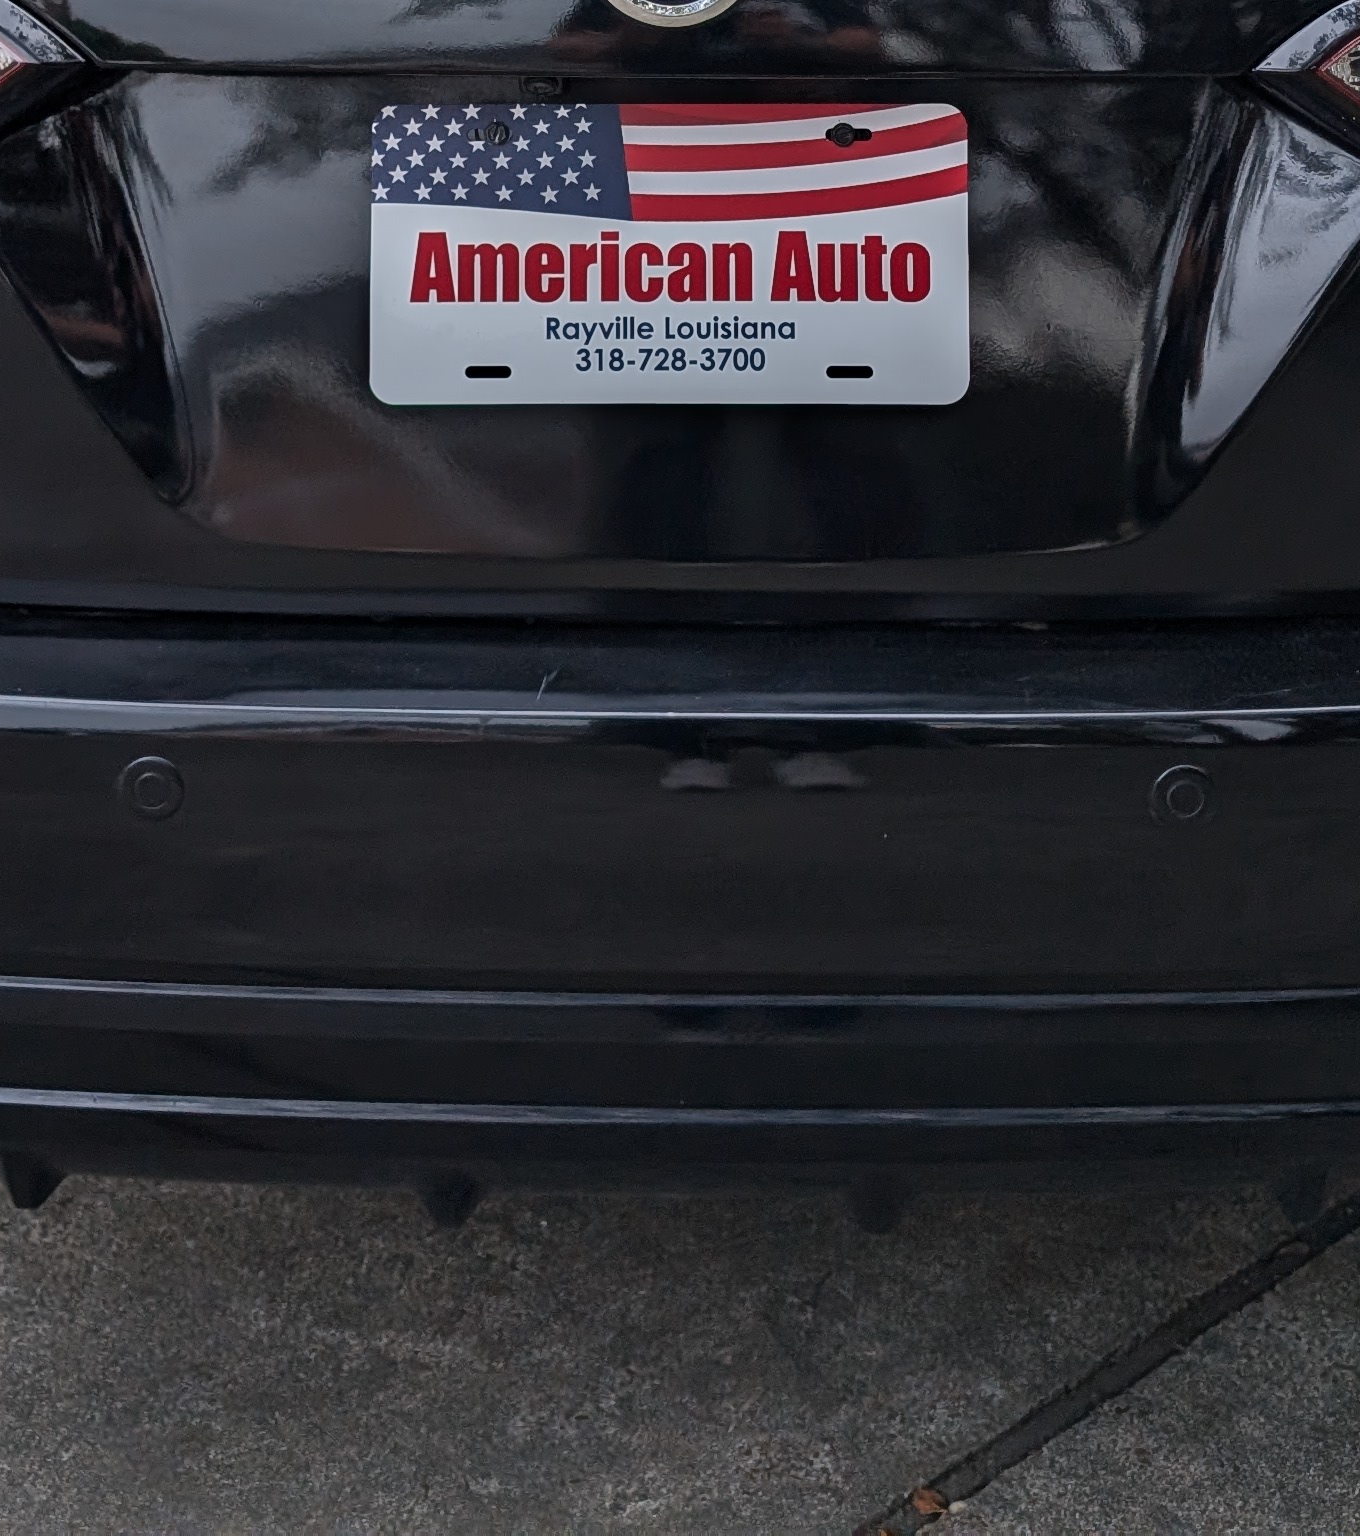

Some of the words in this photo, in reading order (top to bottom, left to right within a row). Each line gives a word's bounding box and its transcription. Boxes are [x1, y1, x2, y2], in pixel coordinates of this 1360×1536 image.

[409, 230, 754, 303] American
[770, 230, 932, 303] Auto
[545, 316, 654, 347] Rayville
[664, 316, 797, 341] Louisiana
[575, 347, 767, 373] 318-728-3700
